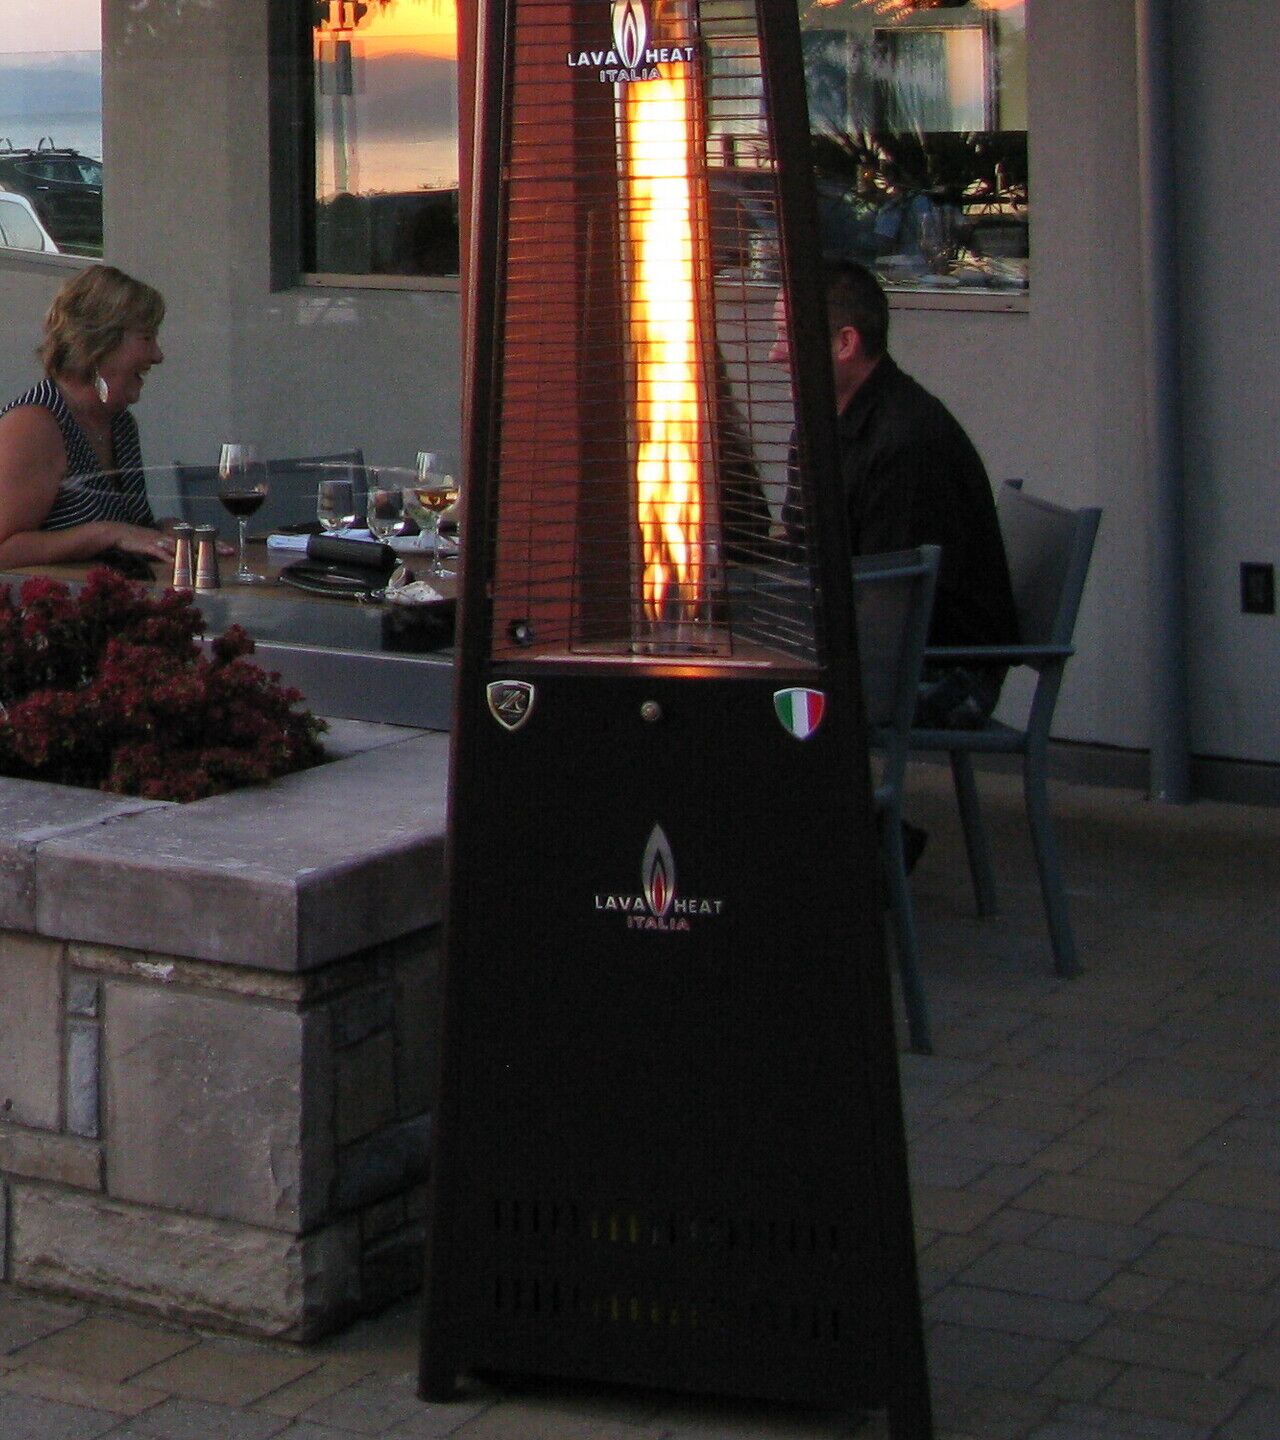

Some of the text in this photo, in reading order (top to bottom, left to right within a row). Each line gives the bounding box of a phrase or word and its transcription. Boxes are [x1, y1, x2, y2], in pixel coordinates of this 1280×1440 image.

[567, 47, 694, 66] LAVA HEAT
[599, 67, 661, 82] ITALIA
[594, 894, 723, 914] LAVA HEAT
[626, 915, 690, 931] ITALIA
